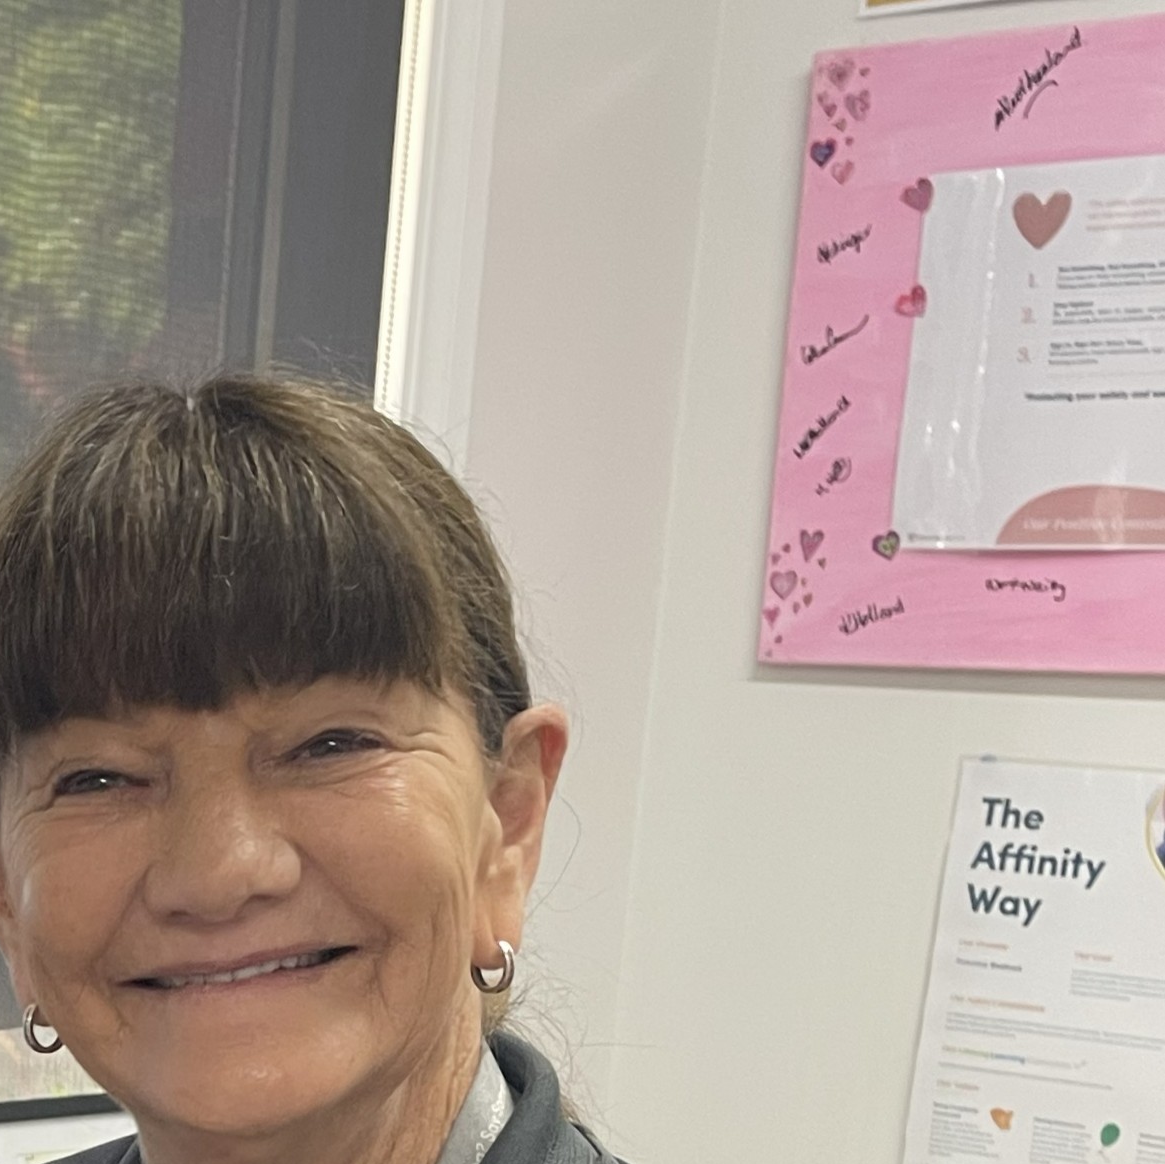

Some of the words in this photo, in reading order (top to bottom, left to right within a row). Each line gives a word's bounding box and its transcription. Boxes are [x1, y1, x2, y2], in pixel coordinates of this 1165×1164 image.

[982, 797, 1044, 831] The
[970, 841, 1106, 890] Affinity
[967, 882, 1042, 928] Way
